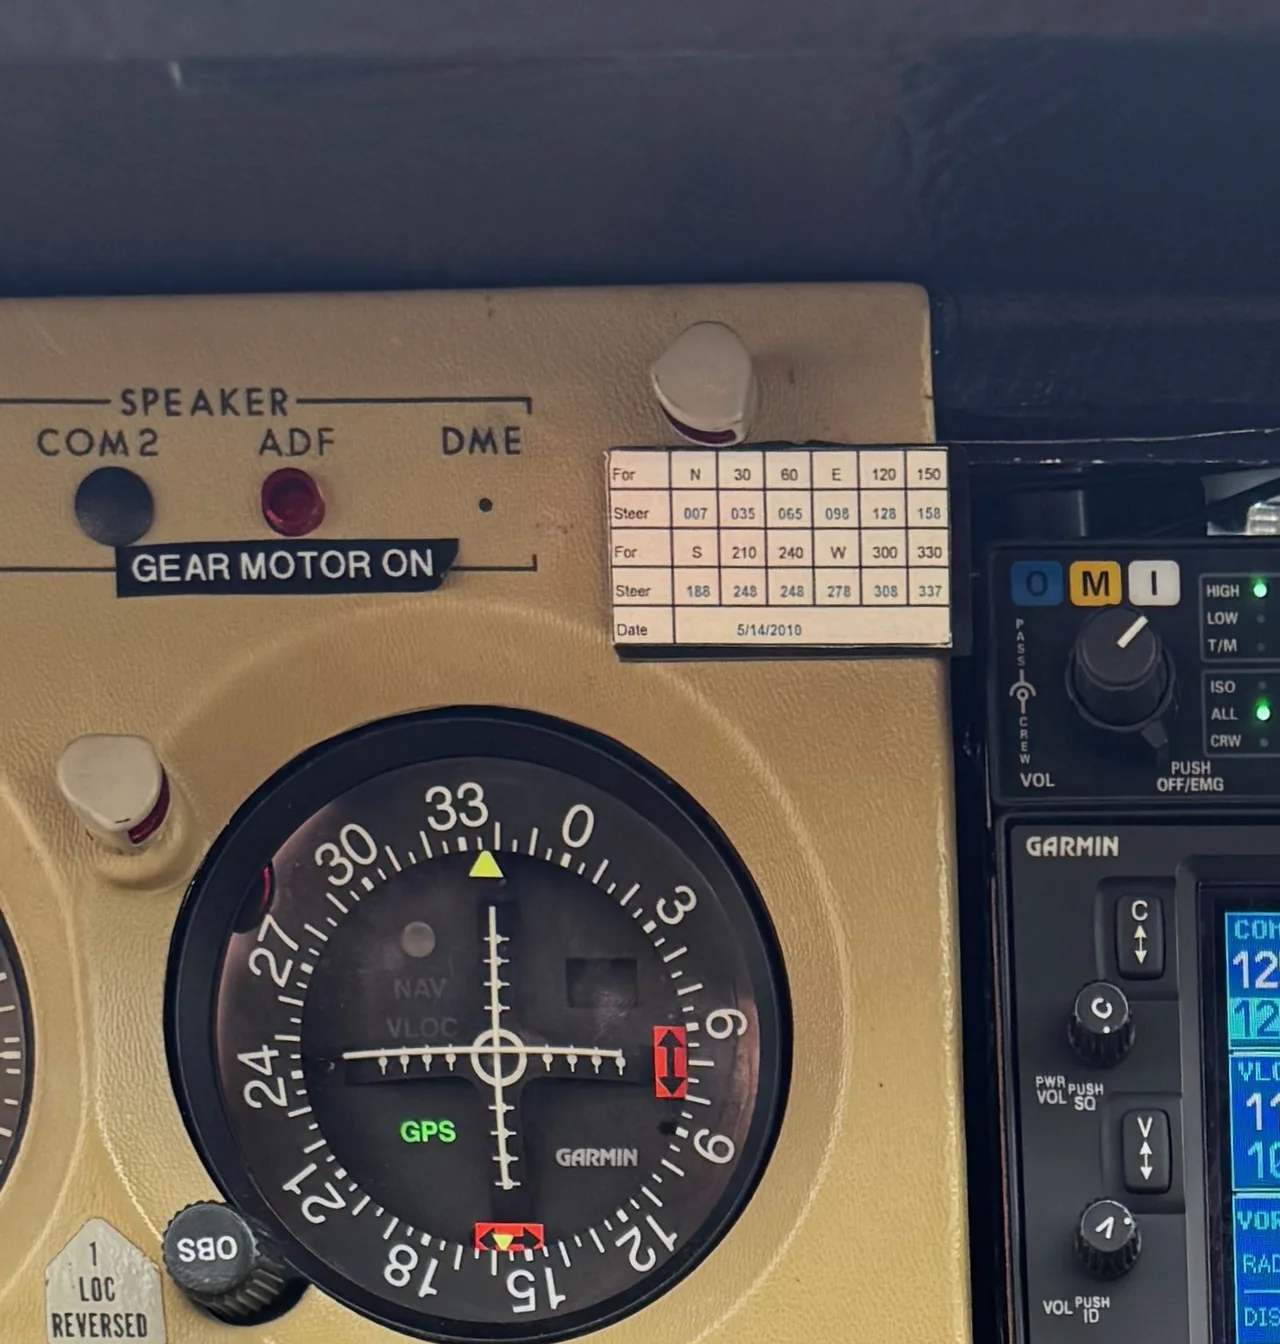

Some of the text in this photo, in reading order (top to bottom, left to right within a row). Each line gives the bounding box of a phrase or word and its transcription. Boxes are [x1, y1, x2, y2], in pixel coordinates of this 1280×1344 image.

[120, 387, 289, 416] SPEAKER
[258, 427, 335, 454] ADF
[442, 427, 522, 454] DME
[614, 507, 649, 519] Steer
[684, 508, 708, 519] 007
[873, 508, 896, 519] 128
[917, 507, 940, 519] 158
[131, 549, 434, 584] GEAR MOTOR ON
[1207, 584, 1240, 598] HIGH
[1208, 612, 1238, 625] LOW
[617, 624, 802, 636] Date 5/14/2010
[1208, 638, 1238, 653] T/M
[1210, 680, 1236, 694] ISO
[1211, 707, 1238, 721] ALL
[1210, 734, 1241, 748] CRW
[1026, 836, 1119, 857] GARMIN
[400, 1121, 457, 1143] GPS
[556, 1148, 638, 1167] GARMIN
[79, 1278, 116, 1301] LOC
[52, 1312, 148, 1339] REVERSED
